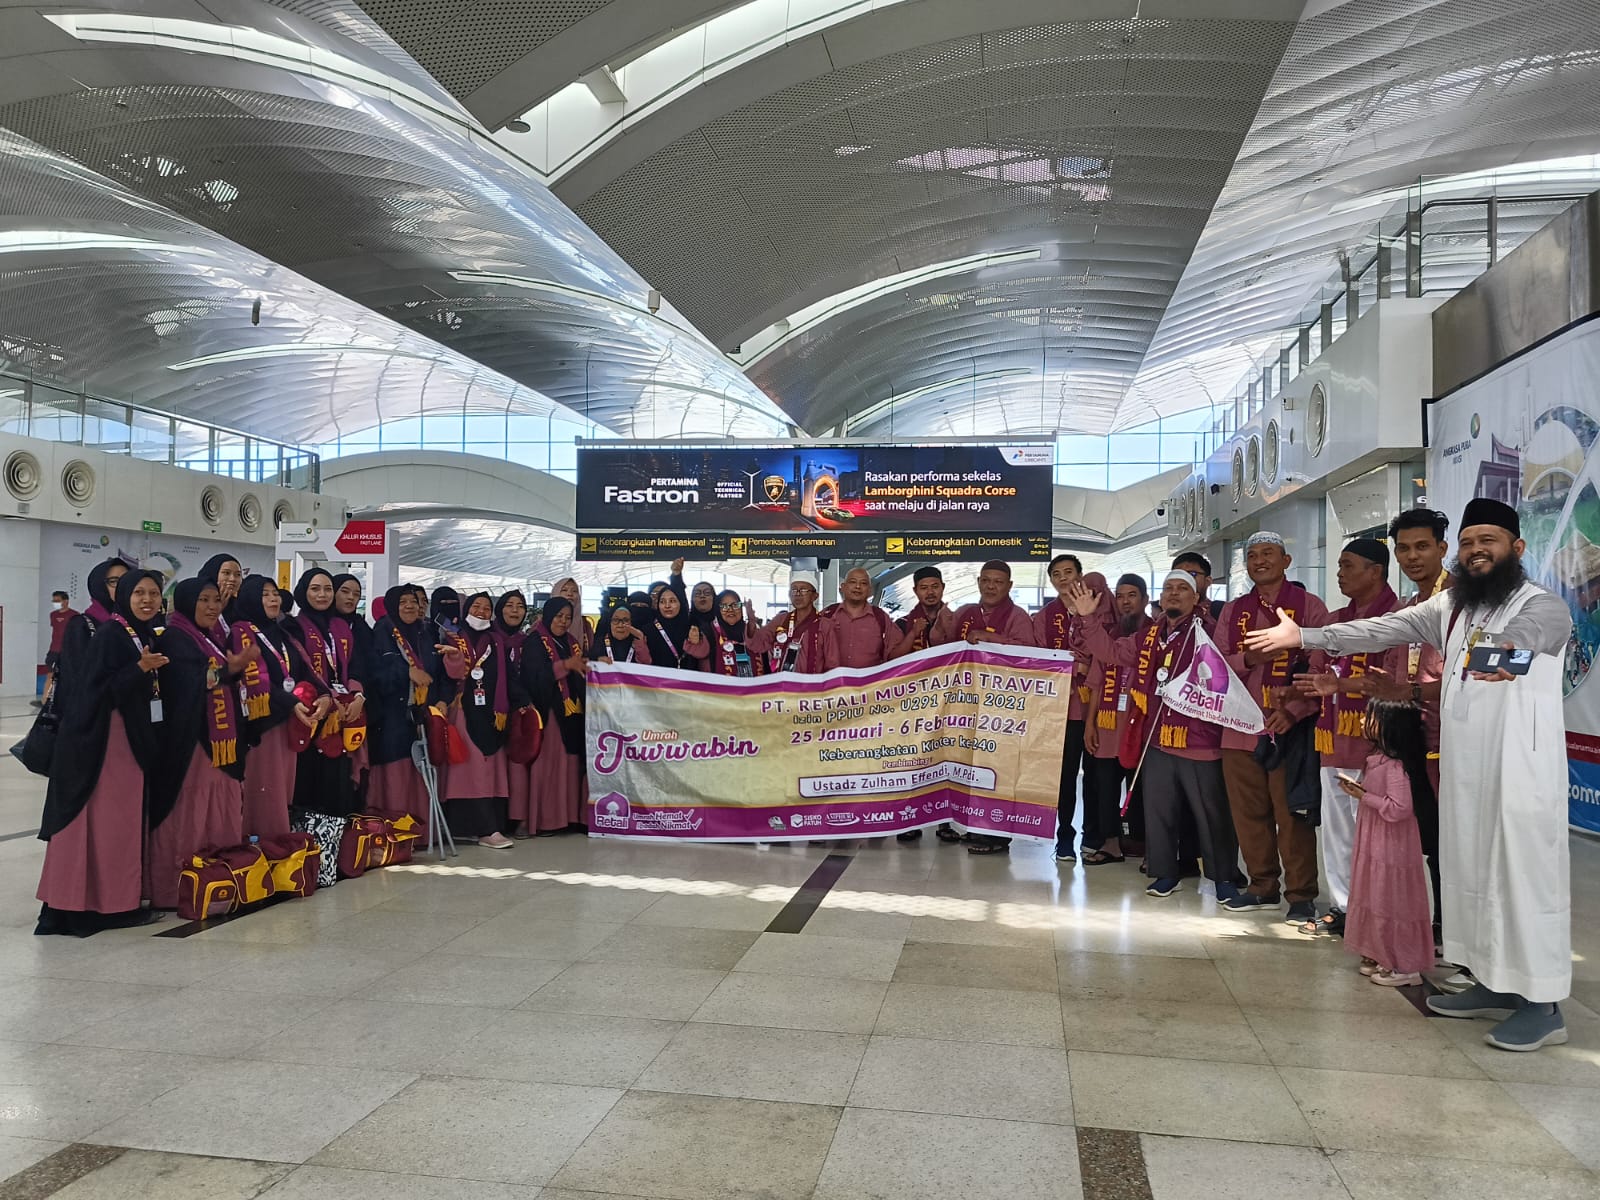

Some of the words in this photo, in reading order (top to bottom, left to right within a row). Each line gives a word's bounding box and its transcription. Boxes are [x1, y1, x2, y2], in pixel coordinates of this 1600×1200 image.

[650, 478, 699, 486] PERTAMINA
[865, 471, 908, 482] Rasakan
[910, 471, 960, 484] performa
[962, 471, 1001, 481] sekelas
[604, 486, 699, 504] Fastron
[865, 486, 935, 498] Lamborghini
[936, 486, 983, 498] Squadra
[984, 486, 1017, 496] Corse
[865, 501, 886, 511] saat
[888, 500, 924, 512] melaju
[926, 500, 937, 511] di
[937, 500, 965, 512] jalan
[966, 502, 990, 512] raya
[600, 537, 656, 548] Keberangkatan
[657, 537, 706, 547] Internasional
[748, 538, 795, 546] Pemeriksaan
[796, 537, 836, 546] Keamanan
[906, 537, 976, 548] Keberangkatan
[978, 537, 1022, 546] Domestik
[760, 700, 790, 715] PT.
[799, 694, 867, 712] RETALI
[875, 671, 973, 701] MUSTAJAB
[979, 672, 1058, 697] TRAVEL
[1178, 682, 1225, 713] Retali
[793, 713, 822, 725] Izin
[827, 707, 864, 723] PPIU
[870, 704, 895, 716] No.
[900, 696, 939, 712] U291
[943, 690, 979, 705] Tahun
[983, 693, 1026, 711] 2021
[1161, 692, 1183, 709] Umrah
[1183, 703, 1205, 718] Hemat
[1205, 710, 1229, 724] Ibadah
[1230, 717, 1255, 730] Nikmat
[642, 729, 679, 741] Umrah
[790, 731, 812, 745] 25
[818, 722, 883, 742] Januari
[900, 721, 910, 736] 6
[914, 713, 977, 734] Februari
[976, 715, 1028, 736] 2024
[593, 731, 760, 775] Tawwabin
[819, 743, 918, 761] Keberangkatan
[922, 736, 956, 752] Kloter
[813, 780, 857, 791] Ustadz
[861, 776, 907, 789] Zulham
[911, 764, 951, 785] Effendi,
[952, 766, 979, 782] M.Pdi.
[935, 800, 949, 809] Call
[655, 811, 683, 820] Hemat
[871, 812, 894, 821] KAN
[1006, 815, 1042, 825] retali.id
[596, 815, 629, 829] Retali
[660, 820, 691, 830] Nikmat
